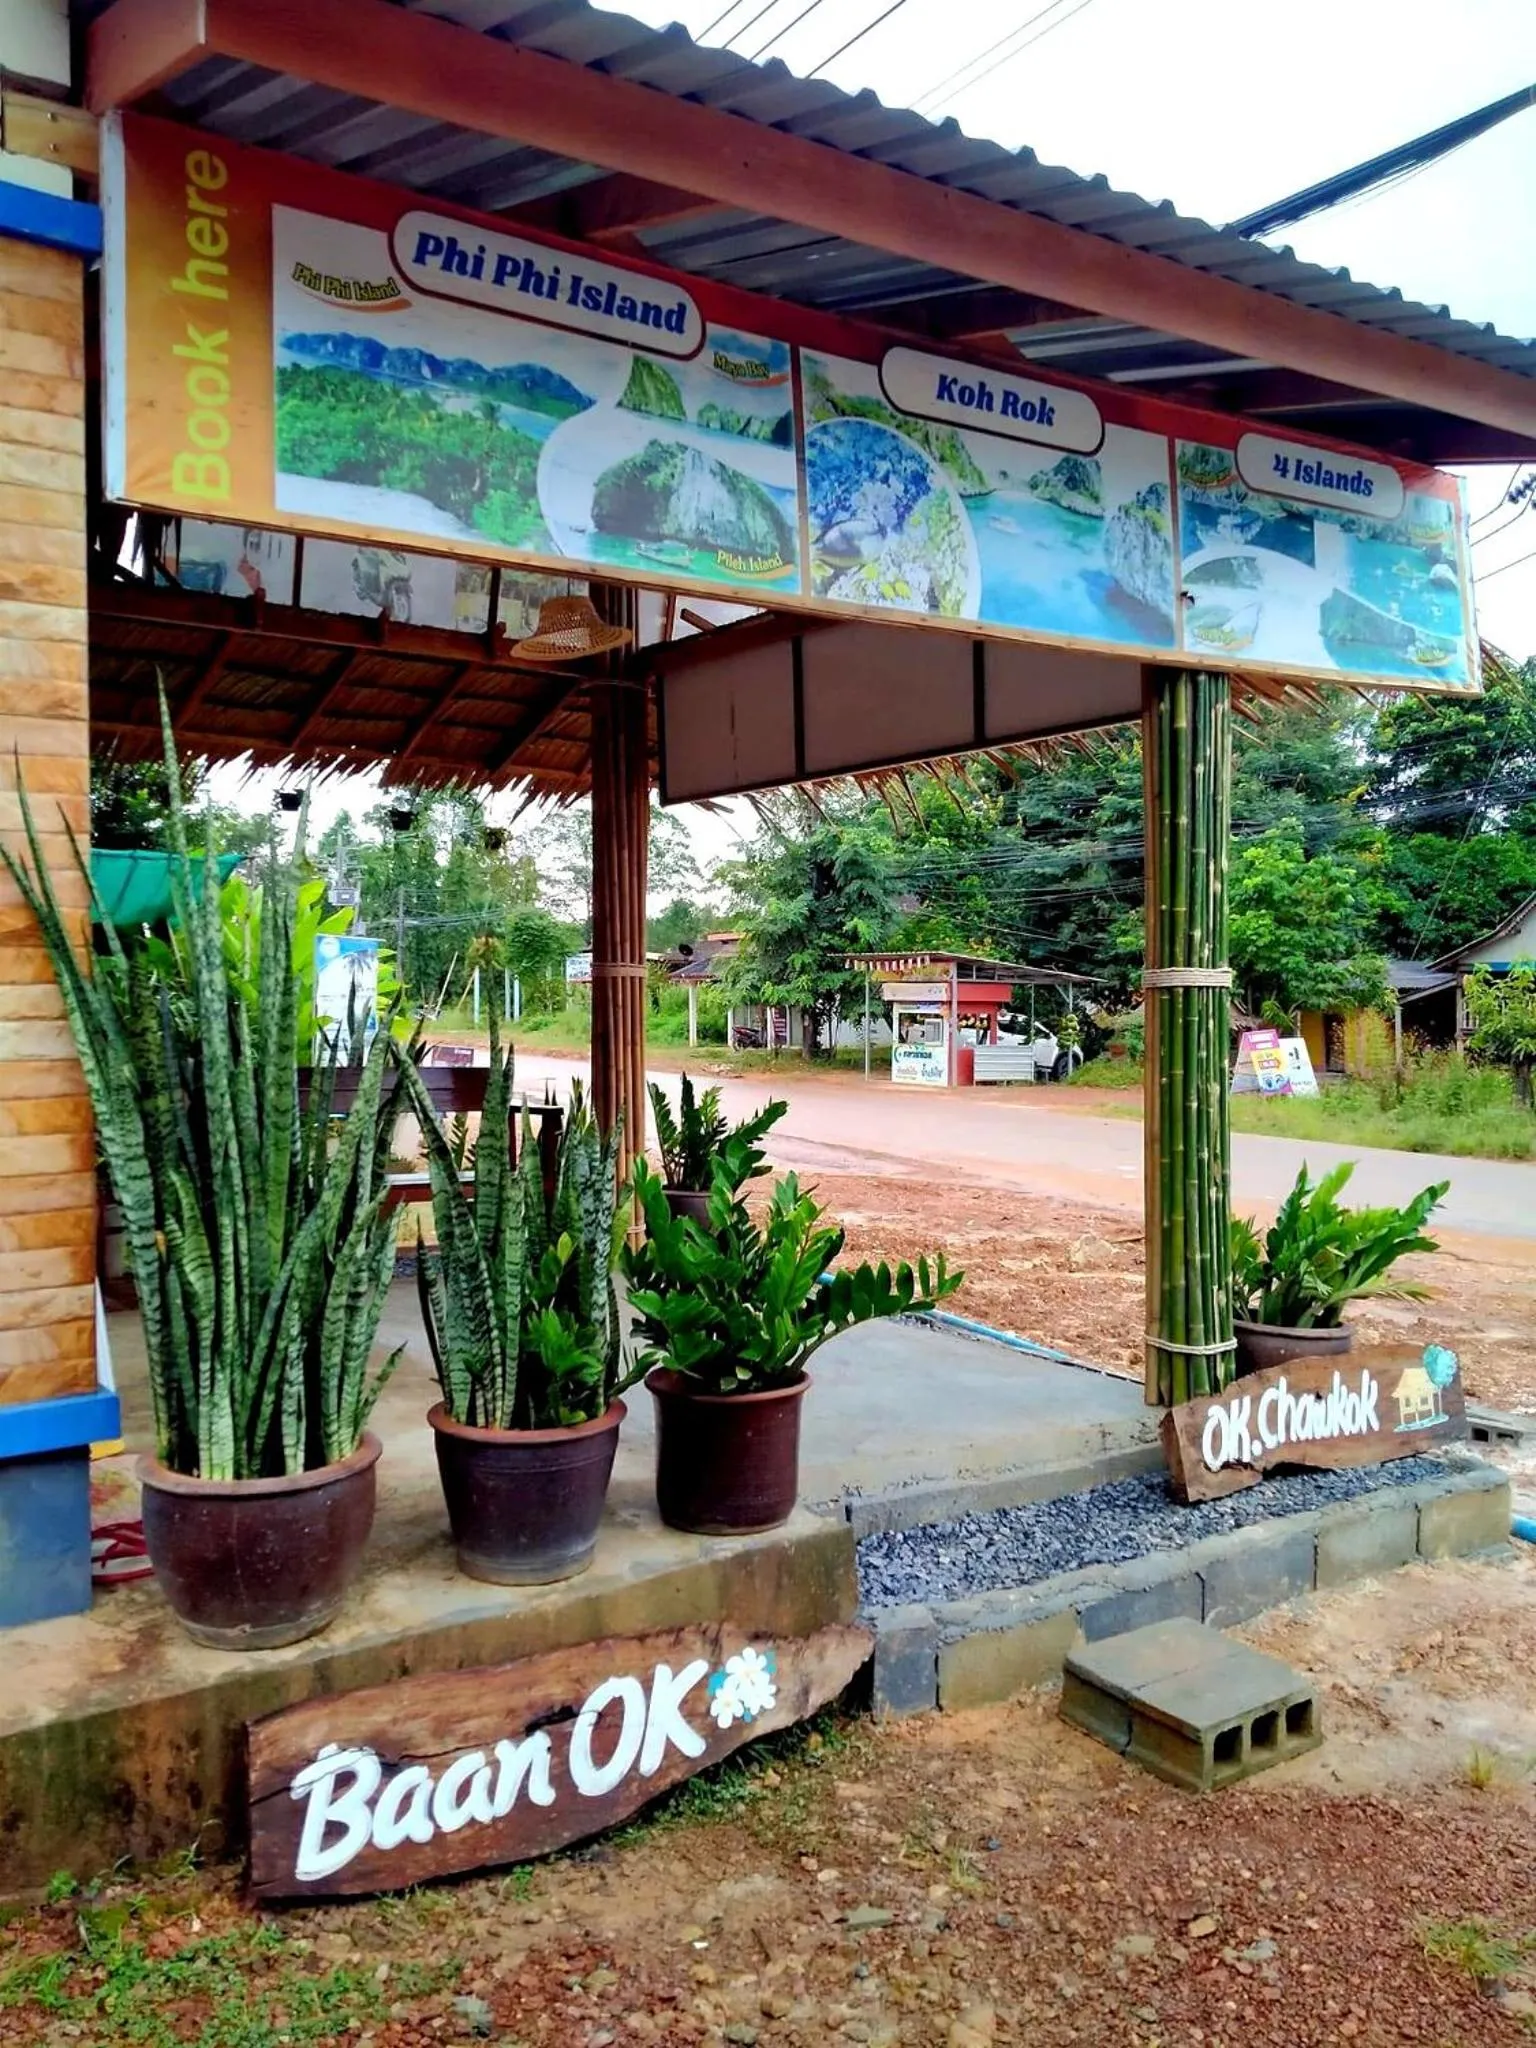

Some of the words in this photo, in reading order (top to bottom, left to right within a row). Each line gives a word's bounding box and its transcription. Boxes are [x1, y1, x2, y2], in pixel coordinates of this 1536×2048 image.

[172, 149, 229, 300] here
[292, 262, 322, 291] Phi
[323, 275, 352, 300] Phi
[353, 276, 401, 301] Island
[412, 231, 486, 280] Phi
[491, 253, 561, 301] Phi
[566, 274, 688, 335] Island
[172, 325, 231, 500] Book
[936, 374, 994, 412] Koh
[1000, 390, 1056, 426] Rok
[1273, 453, 1289, 478] 4
[748, 551, 783, 572] Island
[290, 1728, 556, 1880] Baan
[569, 1657, 710, 1798] OK
